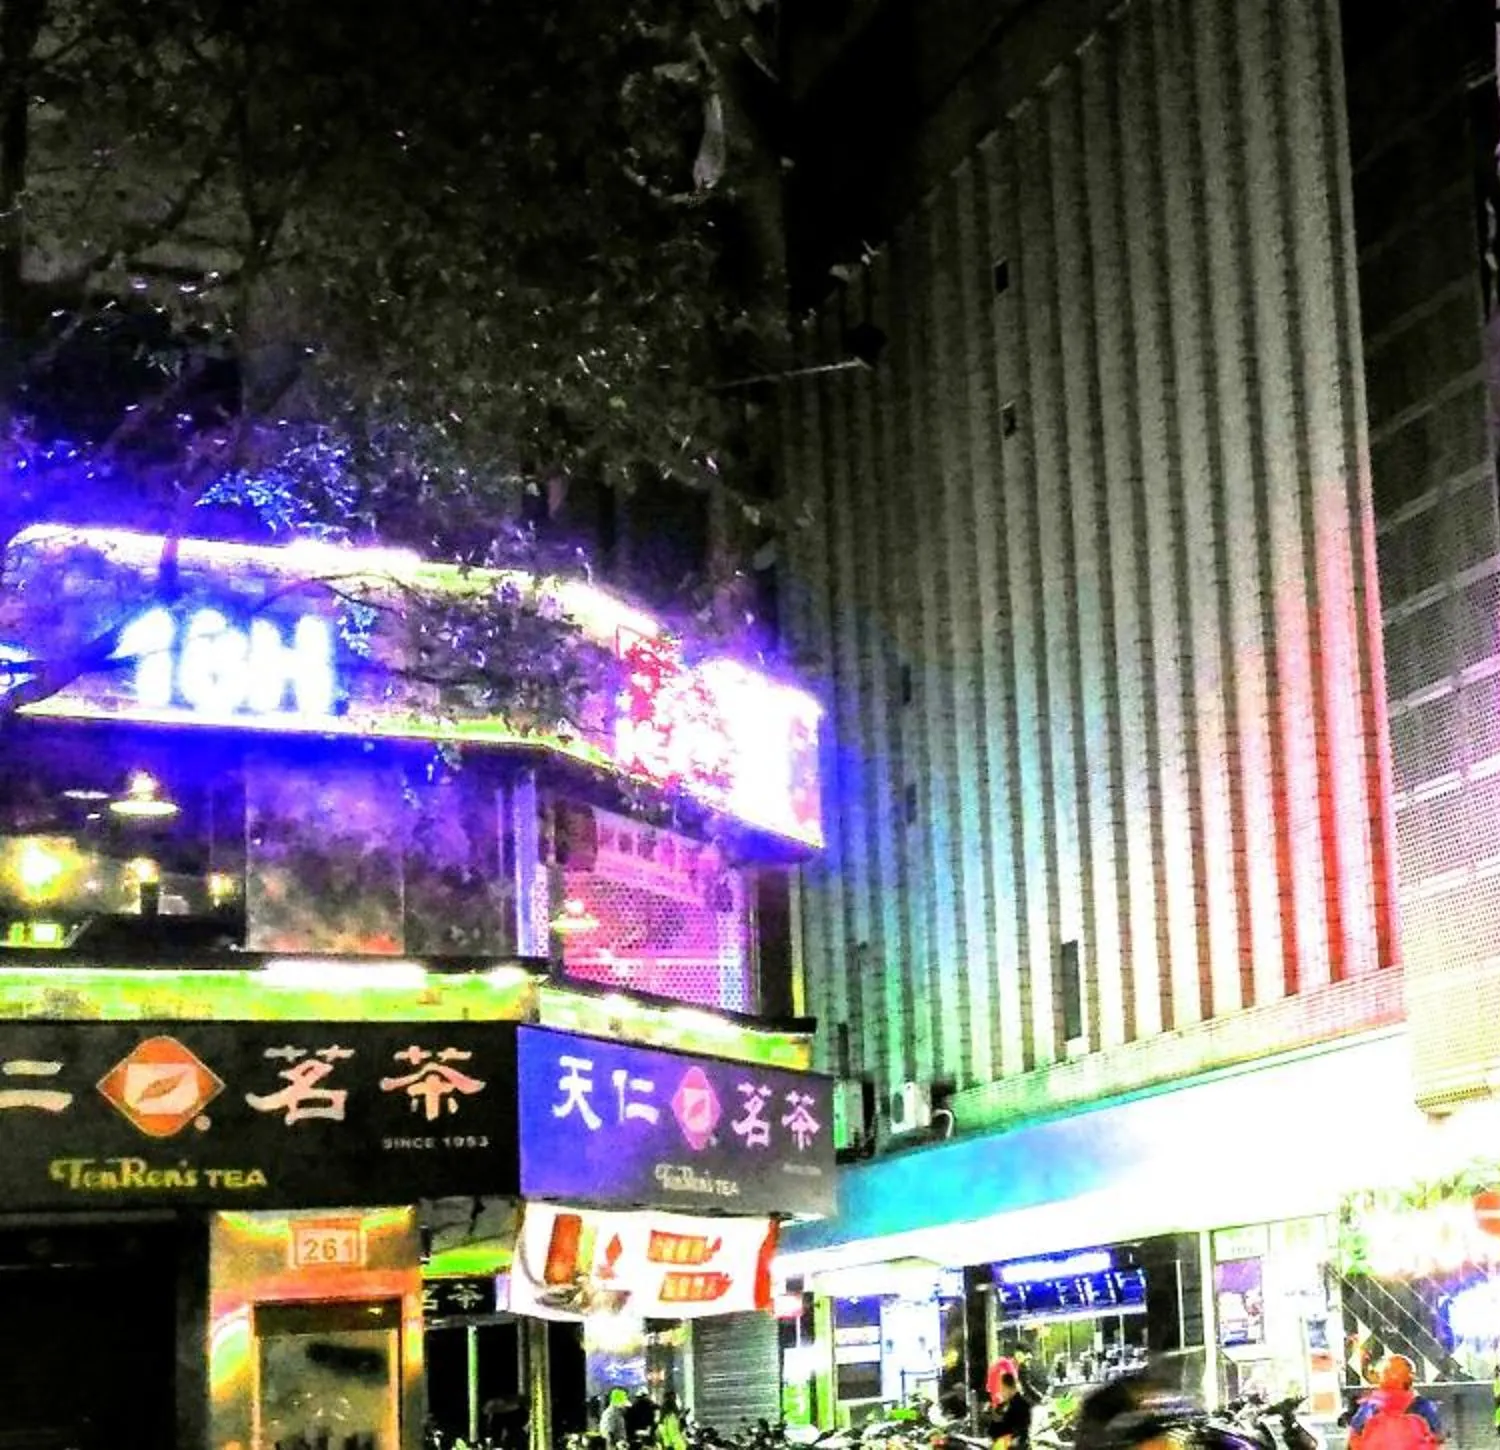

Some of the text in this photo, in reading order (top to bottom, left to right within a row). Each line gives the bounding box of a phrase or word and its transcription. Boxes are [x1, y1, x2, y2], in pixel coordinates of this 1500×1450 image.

[246, 1044, 487, 1126] 茗茶
[552, 1054, 821, 1151] 天仁 茗茶
[382, 1137, 434, 1150] SINCE
[204, 1168, 268, 1189] TEA
[304, 1237, 354, 1261] 261
